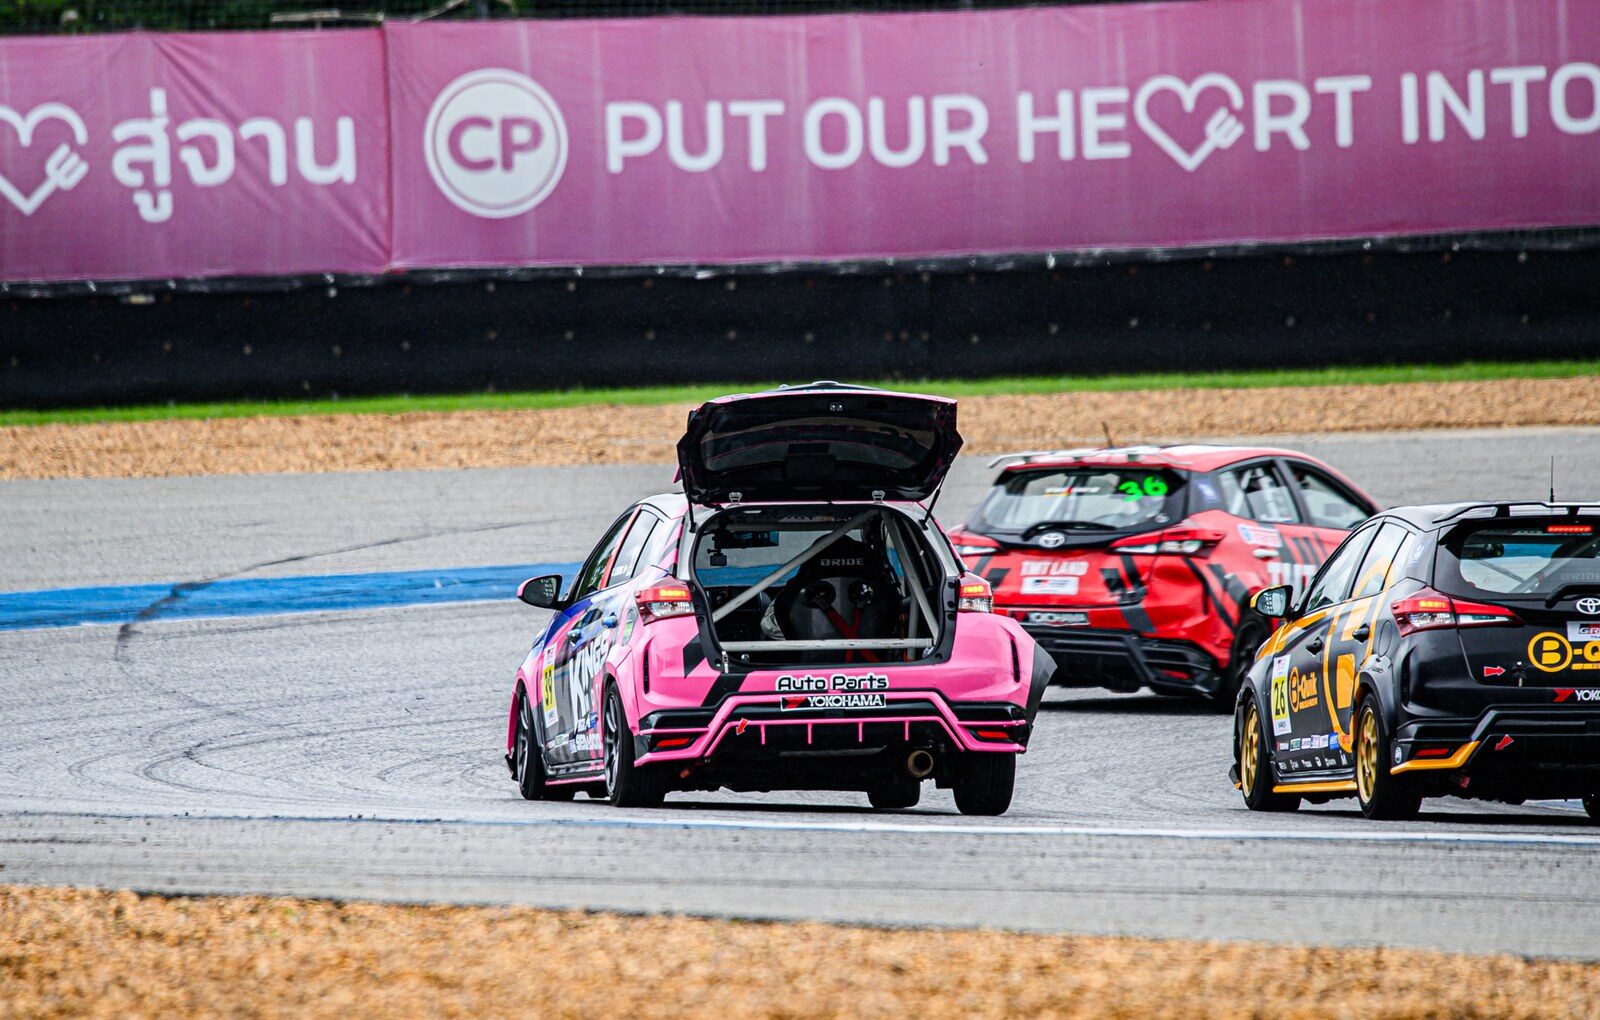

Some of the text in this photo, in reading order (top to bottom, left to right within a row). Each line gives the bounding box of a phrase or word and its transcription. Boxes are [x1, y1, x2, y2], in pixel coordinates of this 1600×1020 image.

[605, 100, 785, 173] PUT
[804, 93, 989, 169] OUR
[1400, 62, 1600, 145] INTO
[112, 88, 357, 222] สู่จาน
[1118, 476, 1168, 503] 36
[820, 557, 865, 567] BRIDE
[777, 675, 888, 691] Auto Parts
[806, 694, 883, 708] YOKOHAMA
[1274, 679, 1286, 716] 26
